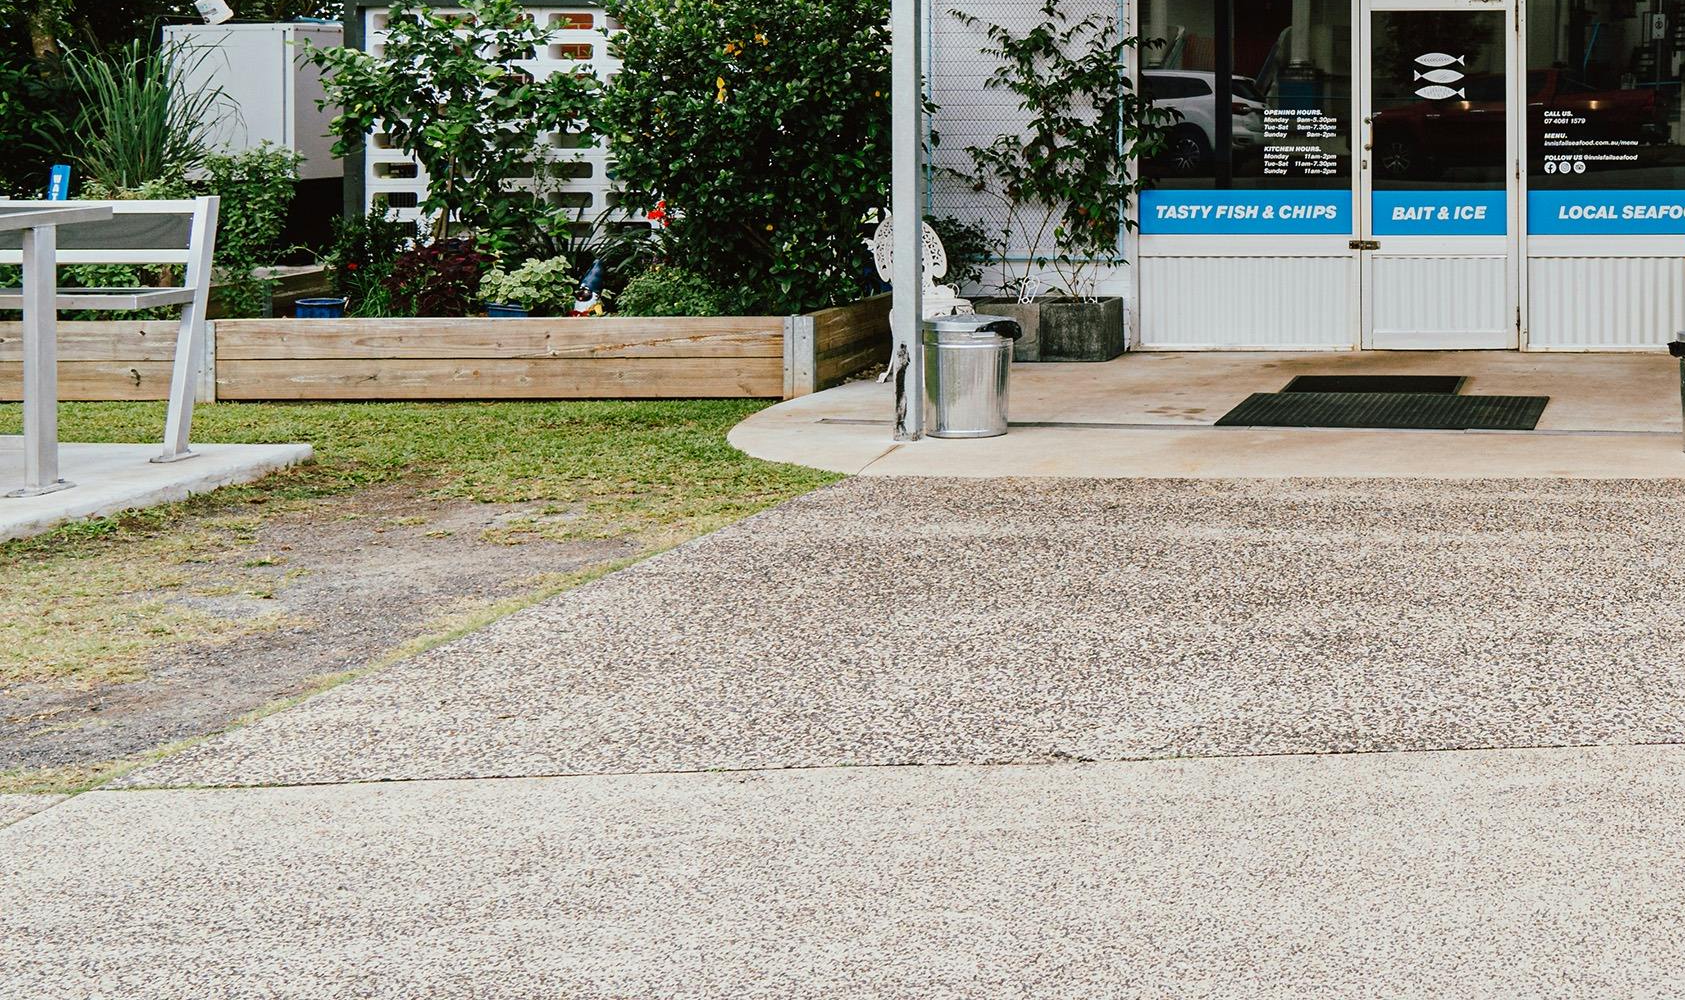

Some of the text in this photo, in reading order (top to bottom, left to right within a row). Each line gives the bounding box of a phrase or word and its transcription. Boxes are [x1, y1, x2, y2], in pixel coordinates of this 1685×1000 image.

[1156, 205, 1337, 219] TASTY FISH & CHIPS
[1392, 206, 1487, 220] BAIT & ICE
[1558, 205, 1618, 220] LOCAL
